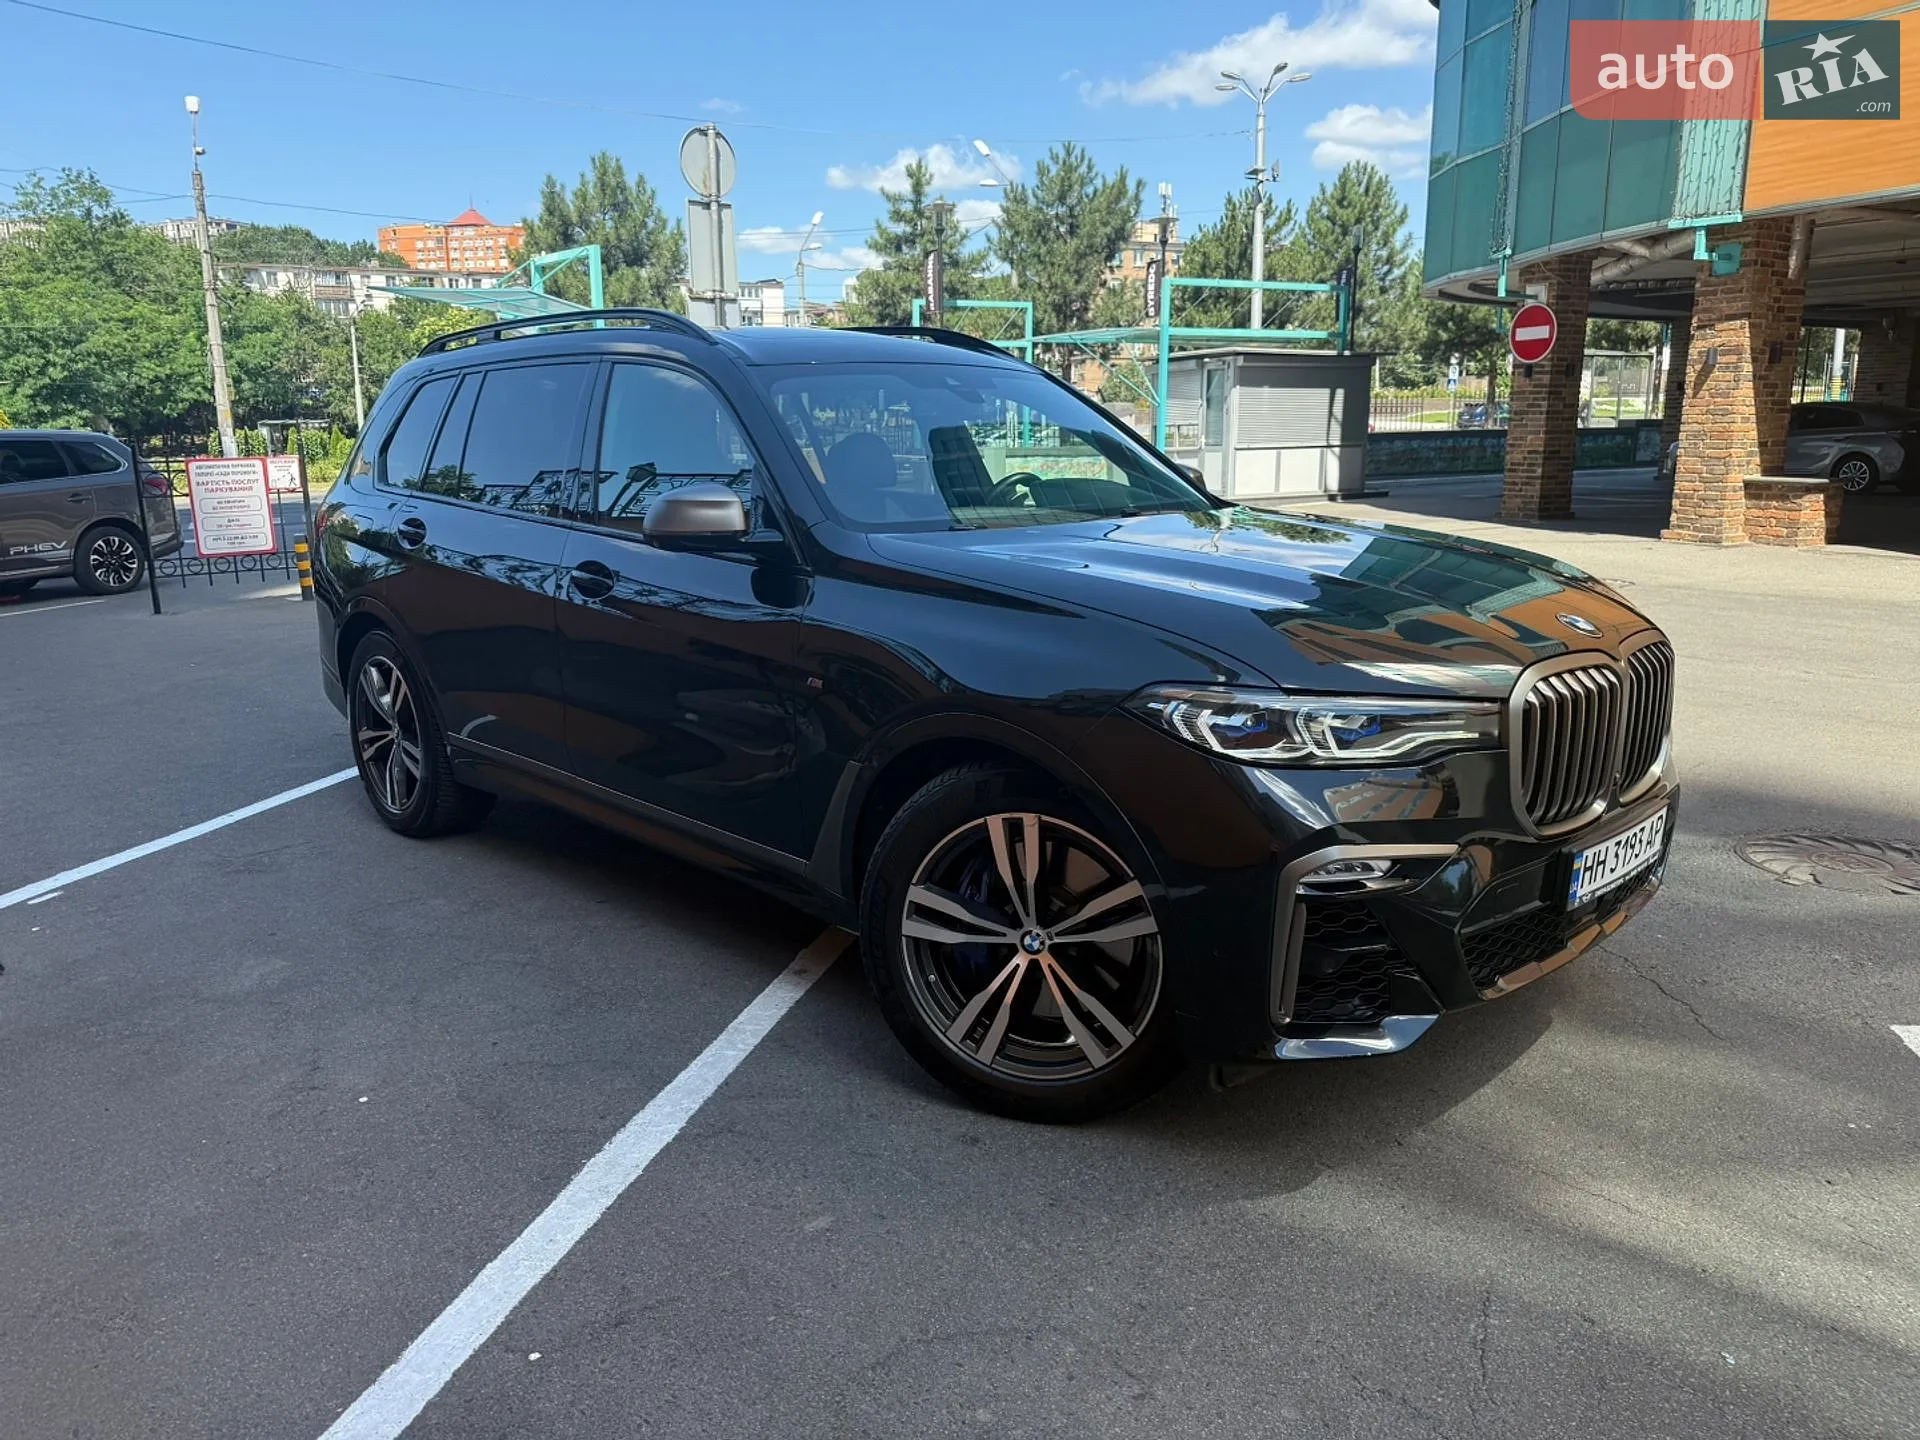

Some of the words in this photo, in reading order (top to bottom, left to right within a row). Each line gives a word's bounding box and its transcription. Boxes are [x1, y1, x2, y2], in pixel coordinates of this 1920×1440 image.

[9, 540, 67, 555] PHEV
[1580, 845, 1609, 889] HH
[1610, 826, 1646, 874] 3193
[1644, 814, 1664, 854] AP
